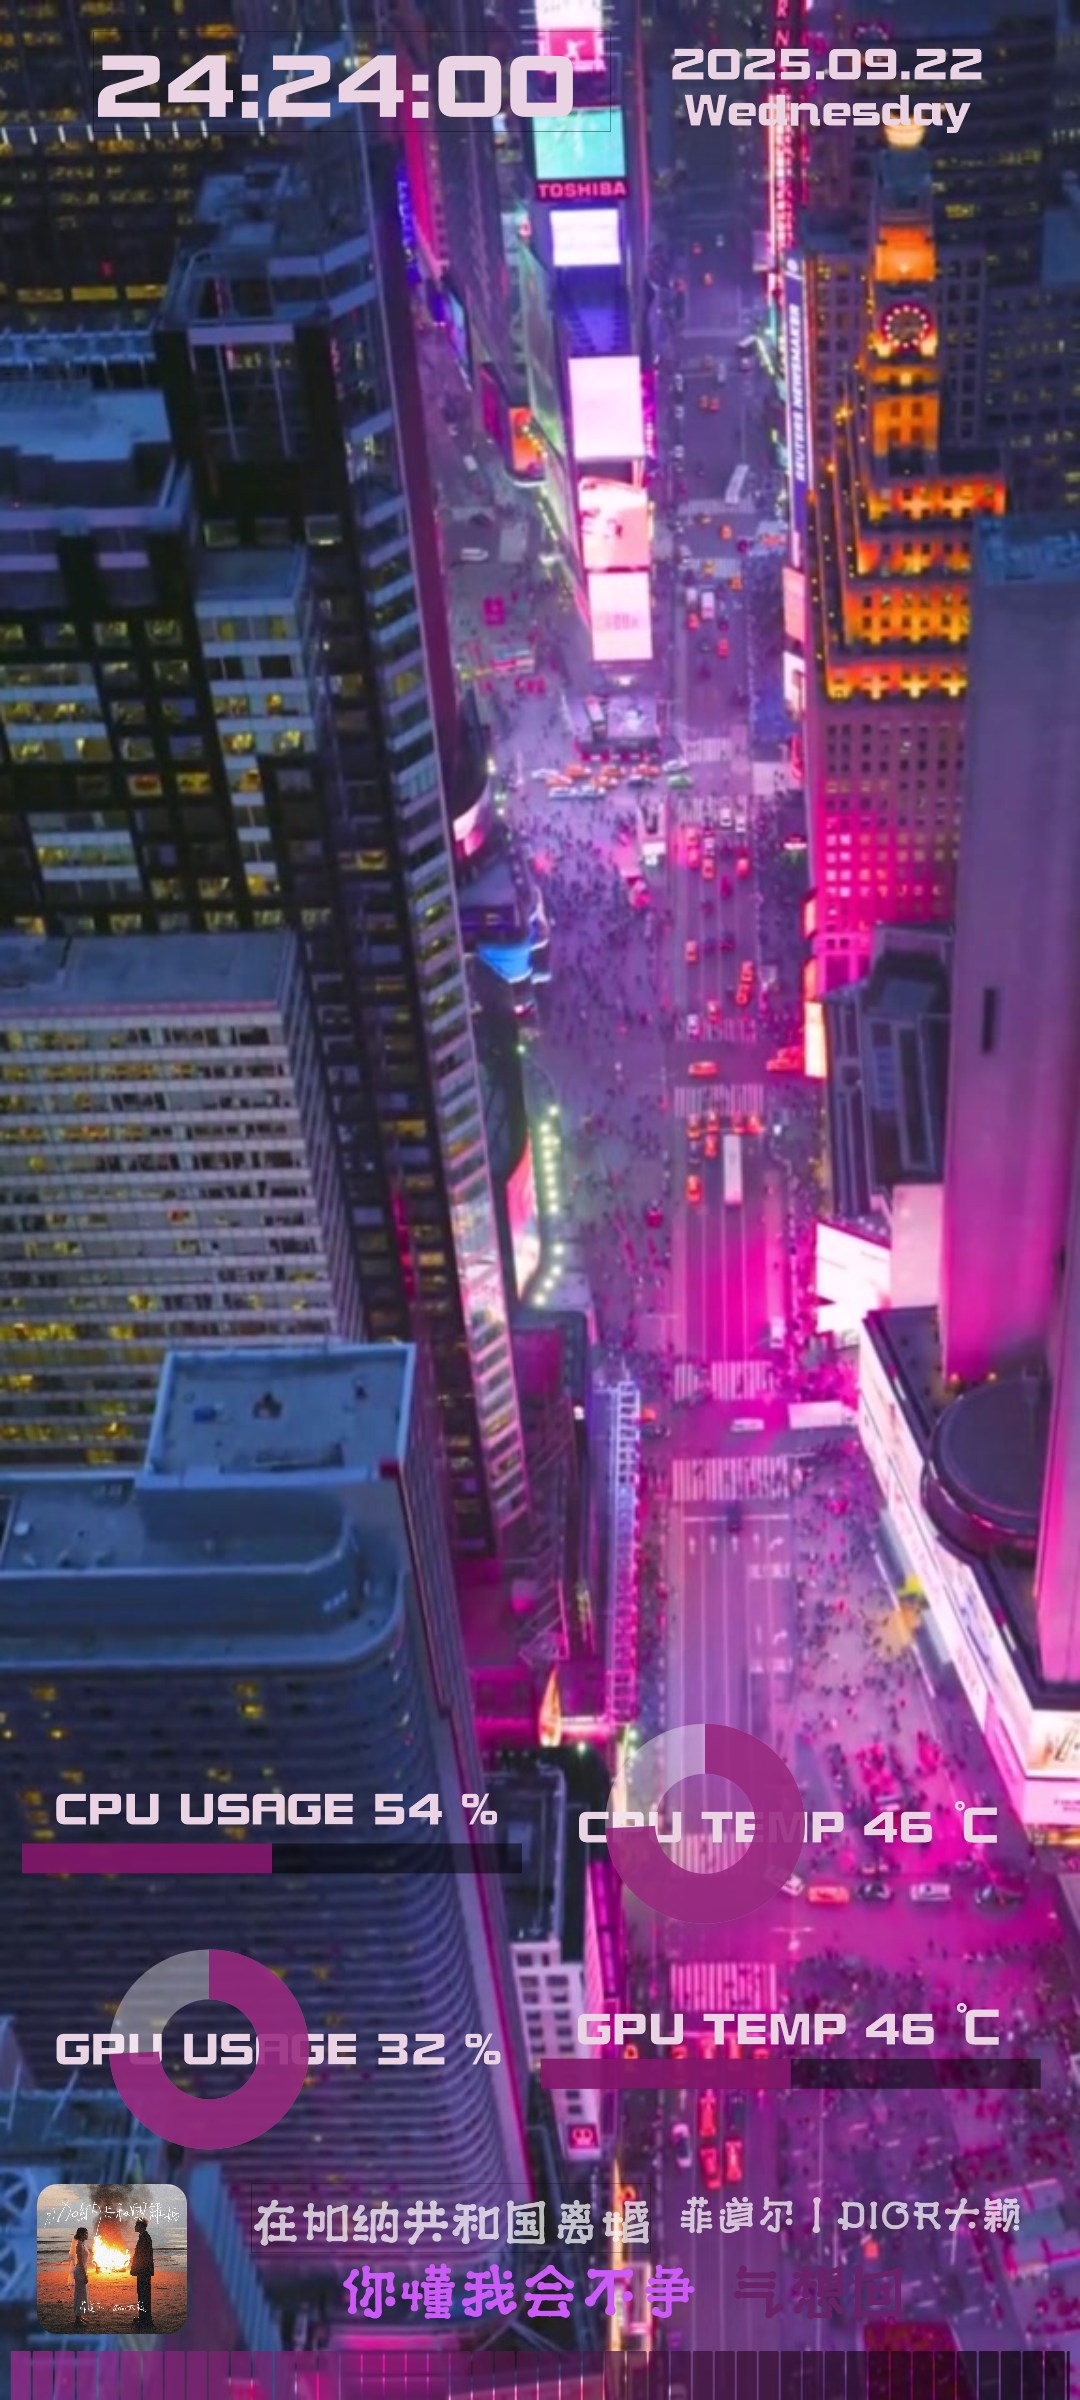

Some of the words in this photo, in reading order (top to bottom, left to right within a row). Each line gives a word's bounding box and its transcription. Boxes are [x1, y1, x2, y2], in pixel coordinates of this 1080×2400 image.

[538, 181, 626, 198] TOSHIBA
[789, 303, 804, 408] NEWSMAKER
[792, 412, 806, 481] REUTERS
